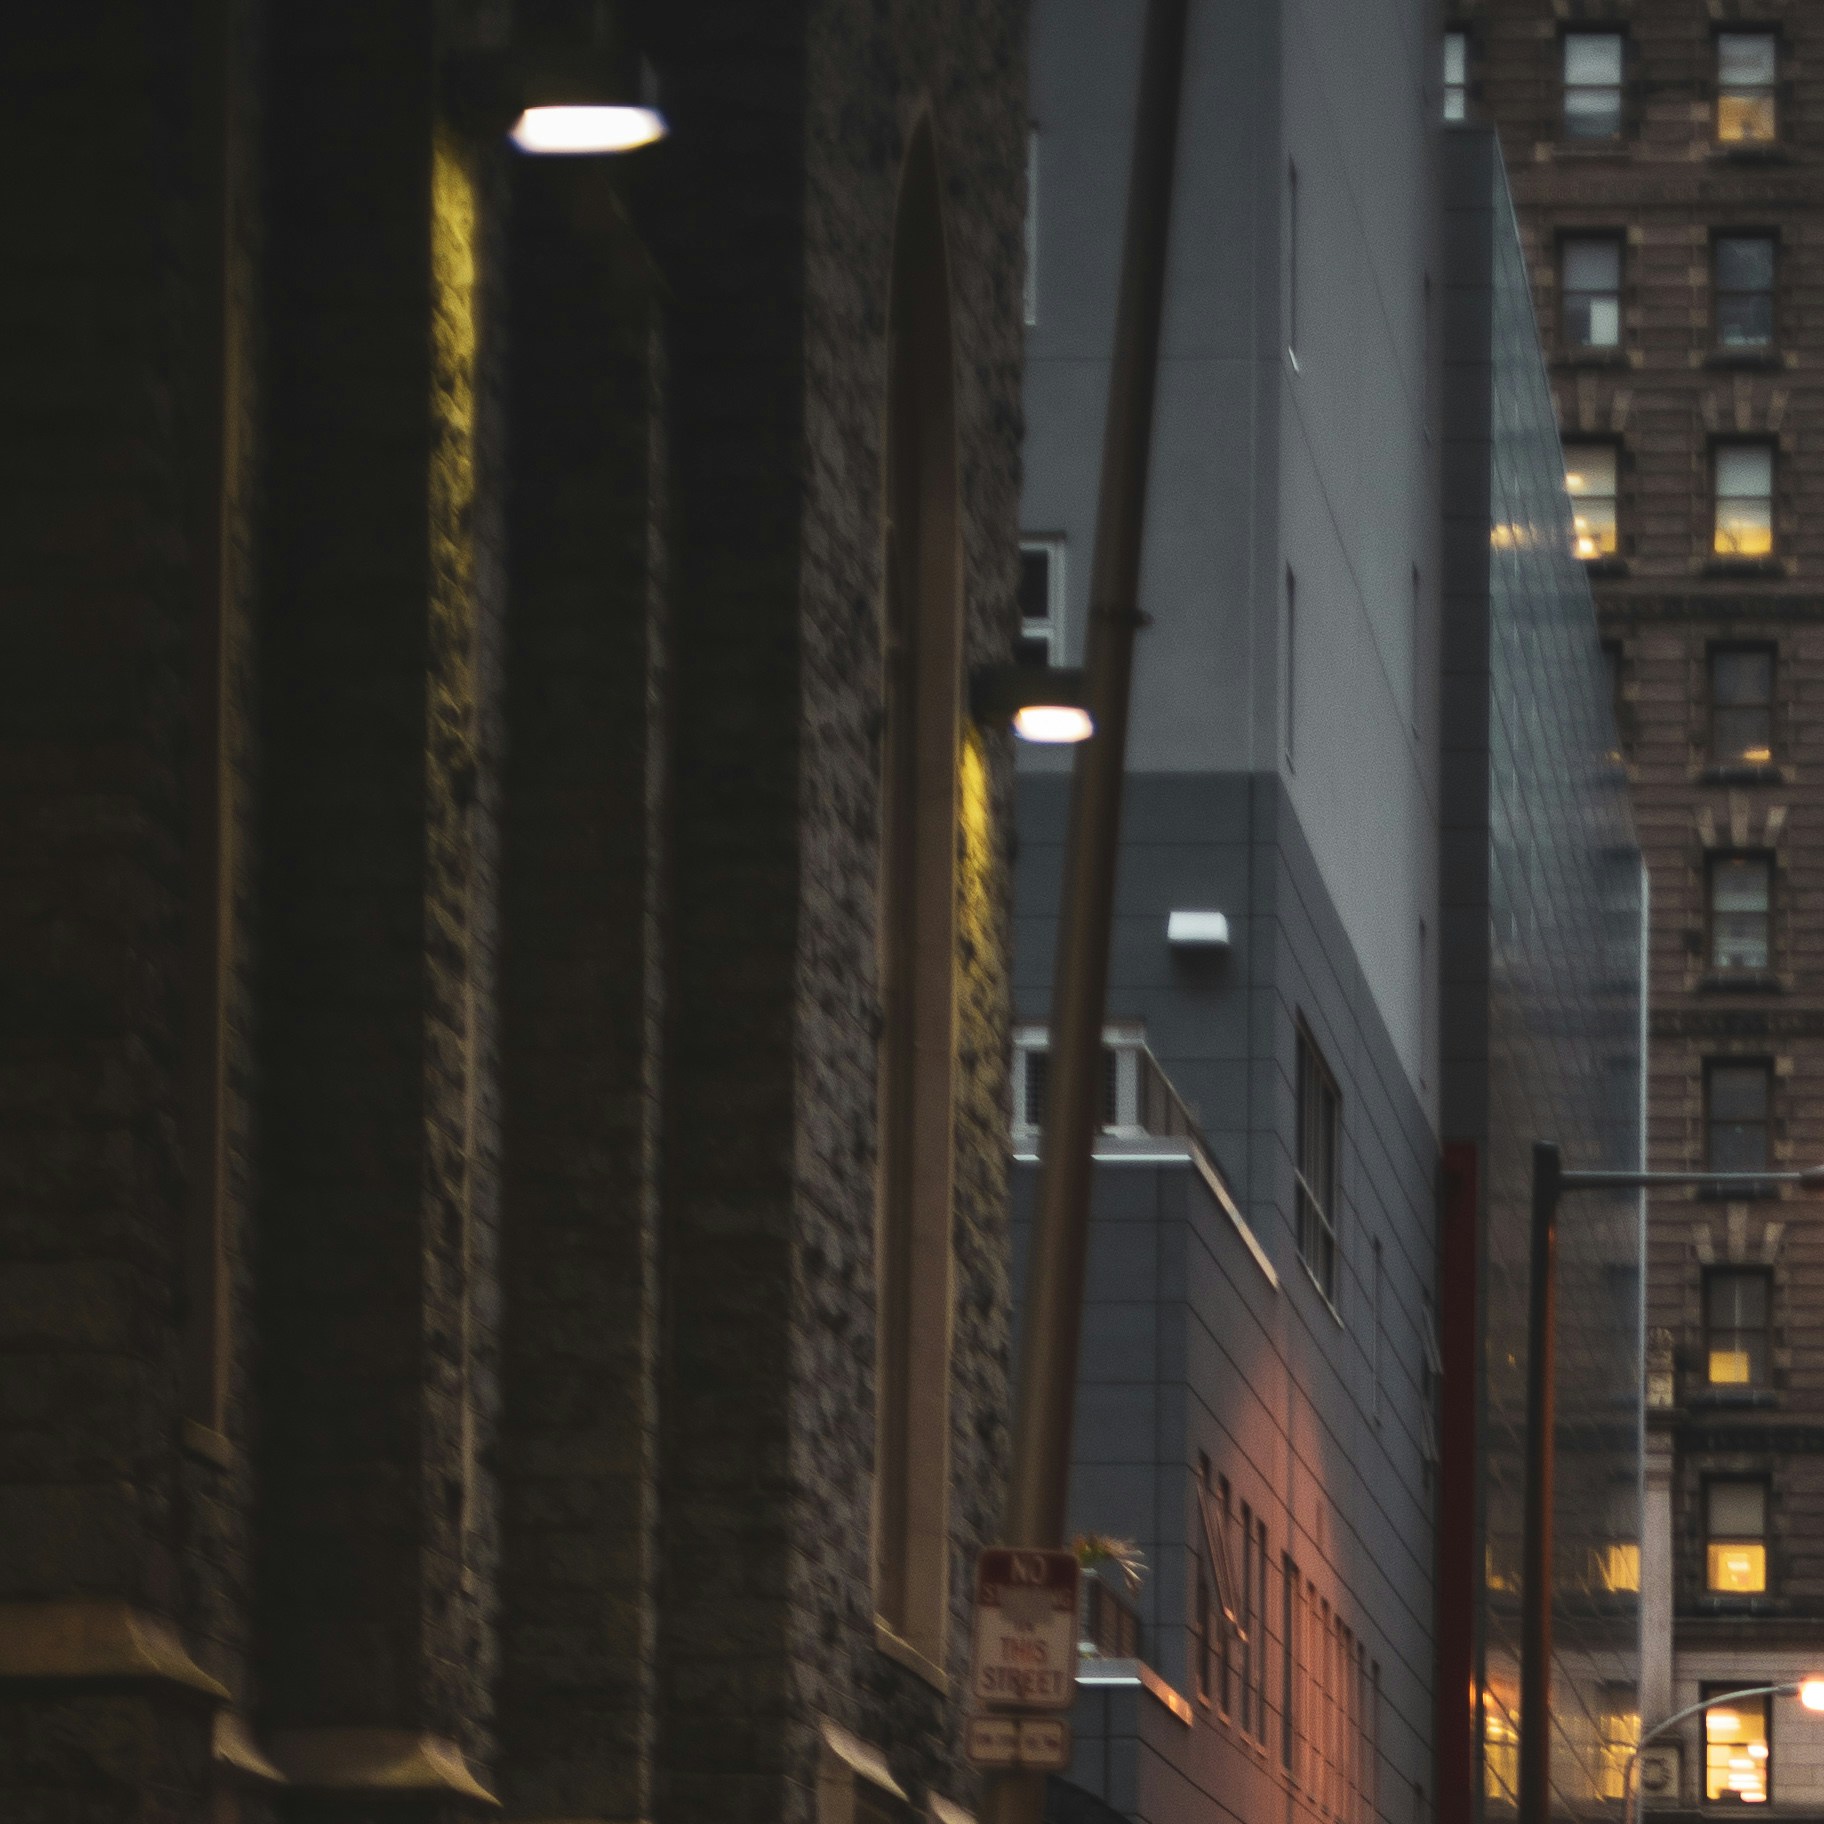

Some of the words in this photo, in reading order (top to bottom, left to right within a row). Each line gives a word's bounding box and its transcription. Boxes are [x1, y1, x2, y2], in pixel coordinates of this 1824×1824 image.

[1011, 1553, 1047, 1584] NO
[1000, 1636, 1048, 1663] THIS
[981, 1667, 1063, 1694] STREET
